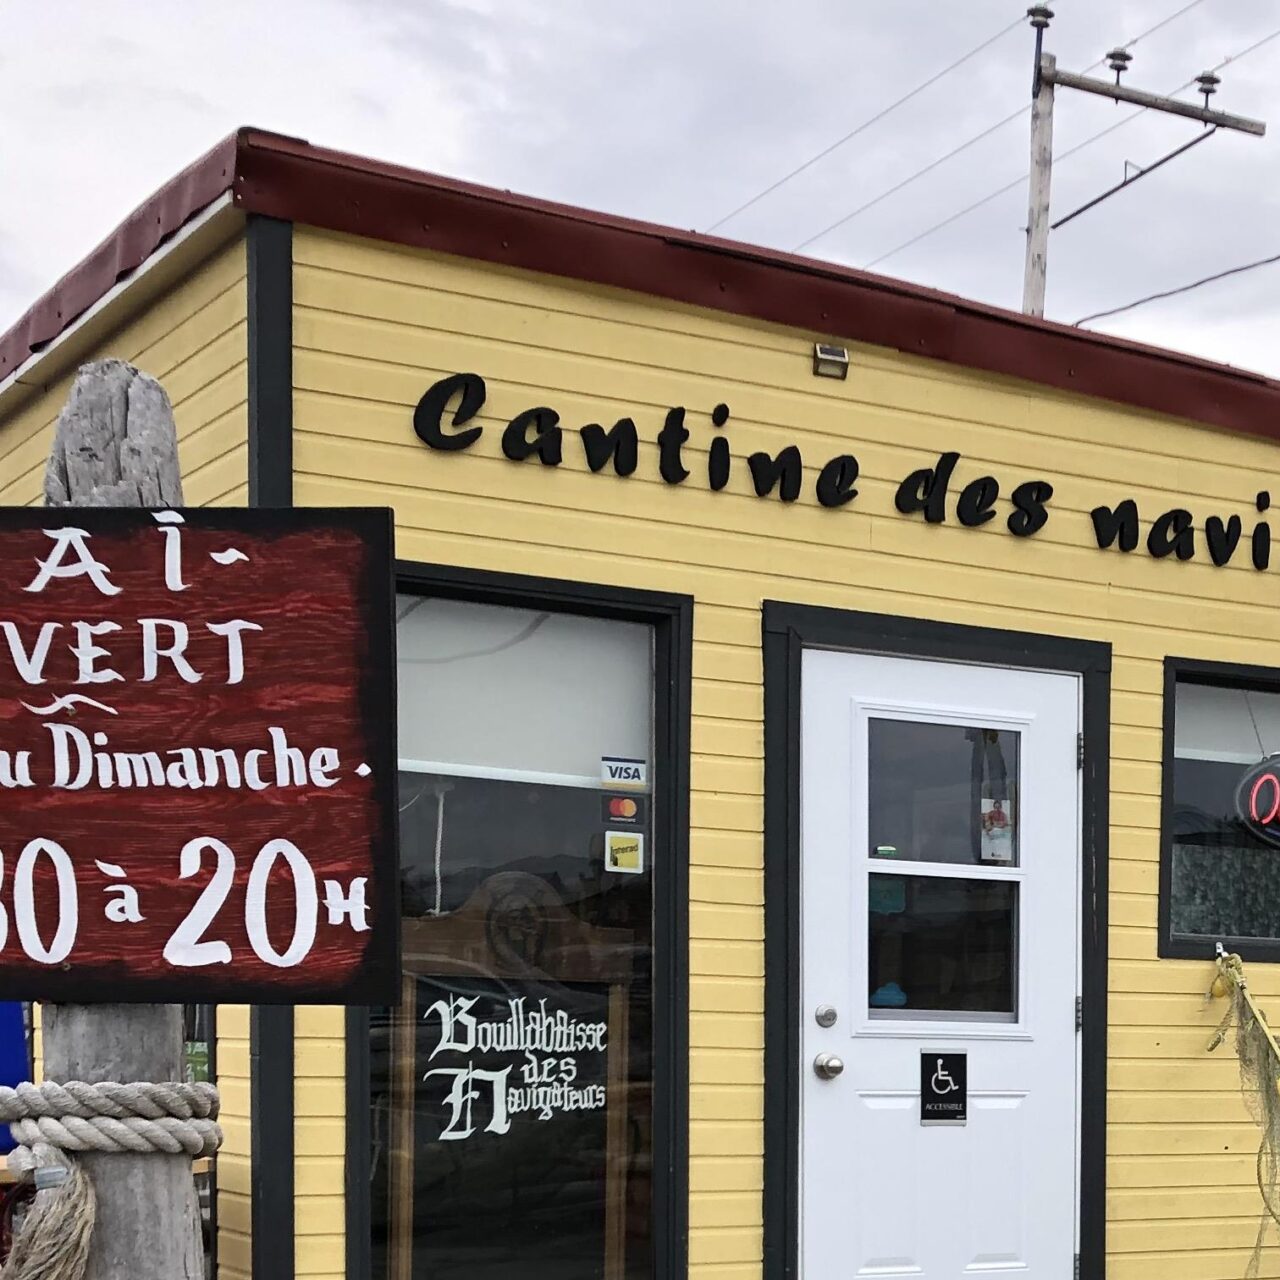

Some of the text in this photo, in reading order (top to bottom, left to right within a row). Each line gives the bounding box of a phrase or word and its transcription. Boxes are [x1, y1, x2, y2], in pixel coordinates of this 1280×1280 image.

[413, 372, 860, 507] Cantine
[895, 451, 1053, 537] des
[1, 618, 264, 685] VERT
[607, 765, 641, 780] VISA
[94, 860, 147, 924] à
[519, 1049, 578, 1084] des
